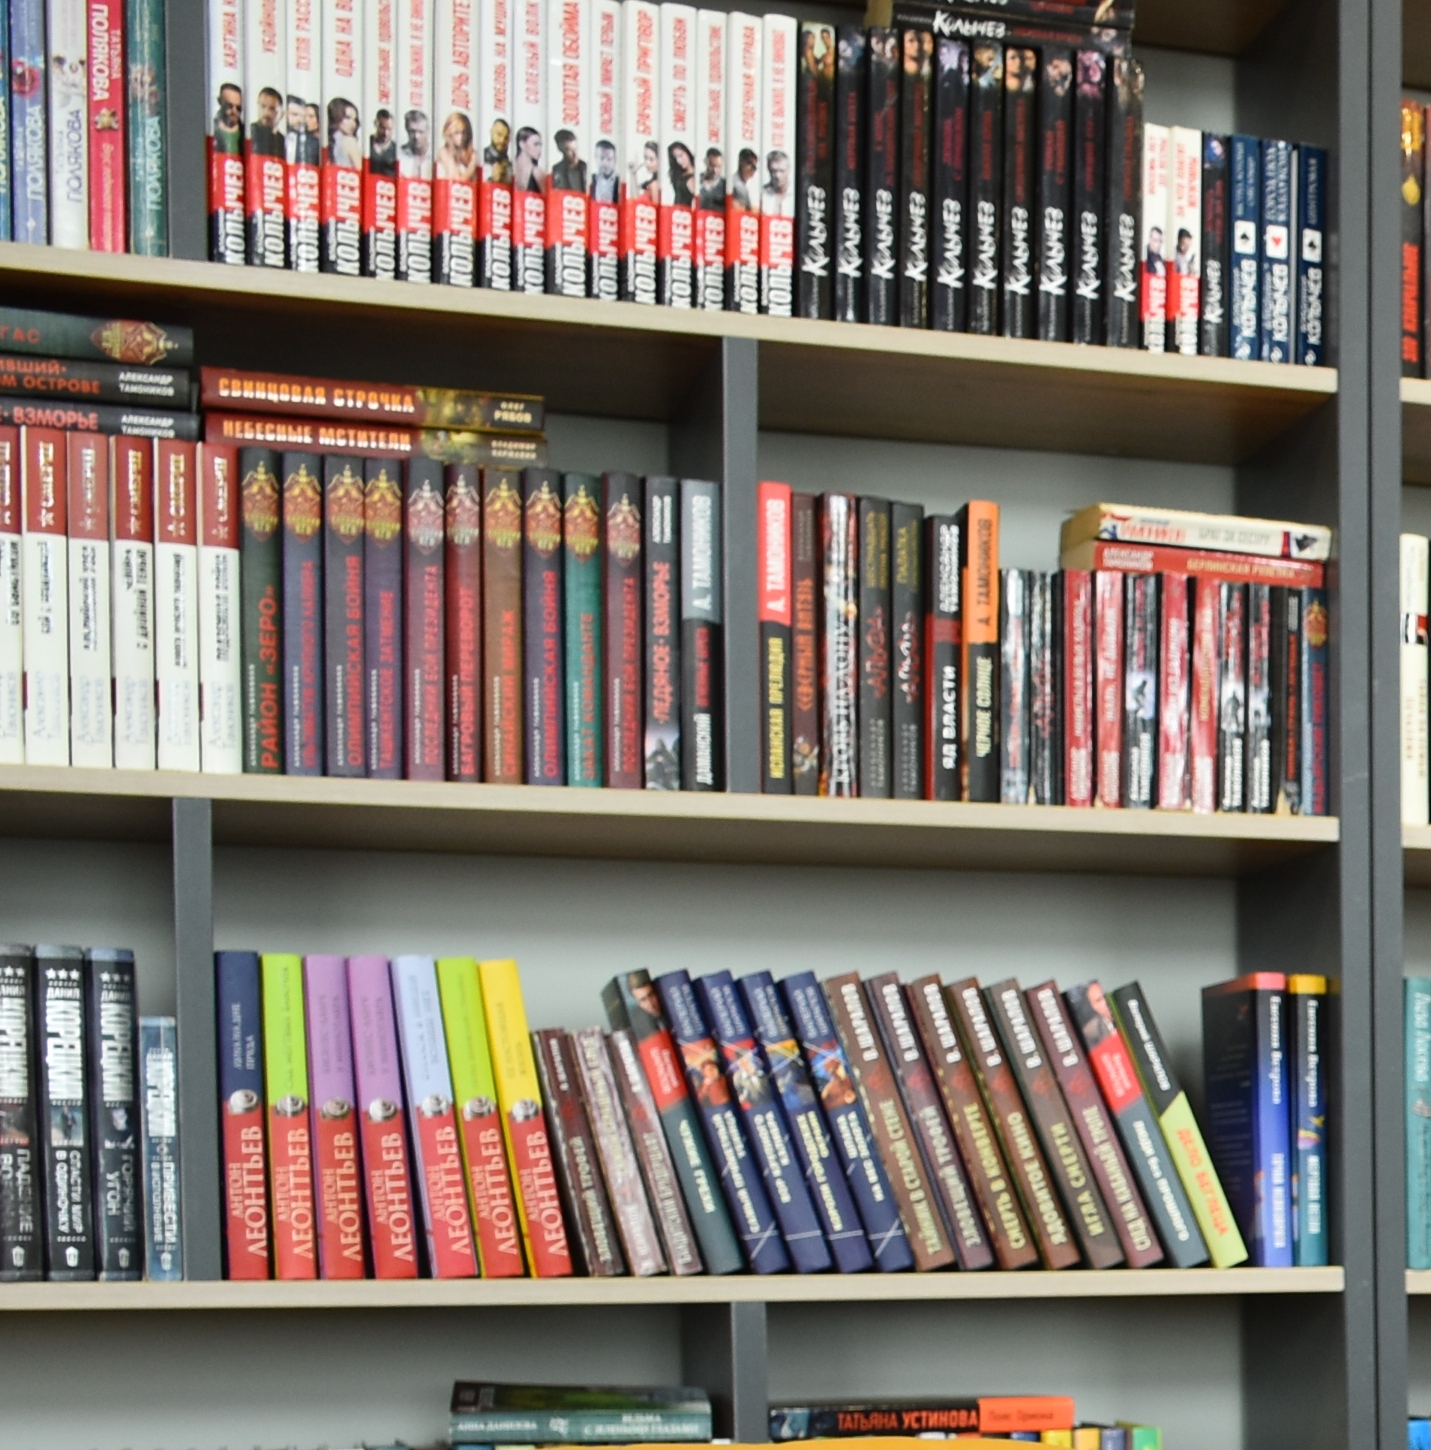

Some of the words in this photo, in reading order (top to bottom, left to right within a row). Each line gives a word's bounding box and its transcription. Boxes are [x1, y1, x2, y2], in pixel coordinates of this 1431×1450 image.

[92, 3, 109, 101] ПОЛЯКОВА
[222, 12, 239, 69] КАРТИНА
[560, 2, 579, 60] ОБОЙМА
[637, 10, 654, 73] ПРИГОВОР
[673, 17, 686, 61] ЛЮБВИ
[452, 70, 470, 111] ДОЧЬ
[562, 63, 579, 126] ЗОЛОТАЯ
[635, 77, 652, 135] БРАЧНЫЙ
[673, 85, 686, 131] СМЕРТЬ
[67, 109, 82, 203] ПОЛЯКОВА
[225, 159, 243, 265] КОЛЫЧЕВ
[264, 161, 284, 268] КОЛЫЧЕВ
[297, 169, 319, 271] КОЛЫЧЕВ
[337, 171, 359, 275] КОЛЫЧЕВ
[376, 180, 395, 280] КОЛЫЧЕВ
[408, 182, 431, 283] КОЛЫЧЕВ
[23, 376, 100, 394] ОСТРОВЕ
[119, 372, 173, 385] АЛЕКСАНДР
[119, 383, 174, 397] ТАМОНИКОВ
[219, 376, 326, 405] СВИНЦОВАЯ
[333, 389, 415, 413] СТРОЧКА
[13, 406, 98, 430] ВЗМОРЬЕ
[122, 415, 174, 428] АЛЕКСАНДР
[223, 420, 313, 444] НЕБЕСНЫЕ
[319, 426, 411, 451] МСТИТЕЛИ
[692, 495, 712, 588] ТАМОНИКОВ
[767, 499, 785, 592] ТАМОНИКОВ
[345, 556, 362, 619] БОЙНЯ
[542, 570, 557, 633] БОЙНЯ
[653, 561, 671, 636] ВЗМОРЬЕ
[259, 585, 279, 675] «ЗЕРО»
[459, 588, 475, 681] ПЕРЕВОРОТ
[503, 610, 515, 670] МИРАЖ
[346, 624, 363, 766] ОЛИМПИЙСКАЯ
[769, 638, 785, 704] ПРЕЛЮДИЯ
[943, 666, 956, 739] ВЛАСТИ
[977, 656, 993, 707] СОЛНЦЕ
[257, 682, 279, 768] РАЙОН
[459, 686, 475, 775] БАГРОВЫЙ
[502, 675, 516, 777] СИНАЙСКИЙ
[543, 638, 559, 777] ОЛИМПИЙСКАЯ
[976, 709, 992, 757] ЧЕРНОЕ
[769, 708, 784, 778] ИСПАНСКАЯ
[943, 743, 956, 769] ЯД
[964, 1104, 1000, 1177] КОНВЕРТЕ
[1007, 1112, 1035, 1158] КИНО
[1051, 1123, 1086, 1188] СМЕРТИ
[107, 1171, 120, 1216] УГОН
[229, 1162, 244, 1217] АНТОН
[241, 1126, 268, 1258] ЛЕОНТЬЕВ
[275, 1166, 290, 1222] АНТОН
[288, 1127, 314, 1259] ЛЕОНТЬЕВ
[323, 1168, 338, 1223] АНТОН
[334, 1131, 362, 1261] ЛЕОНТЬЕВ
[380, 1132, 414, 1262] ЛЕОНТЬЕВ
[436, 1126, 472, 1255] ЛЕОНТЬЕВ
[480, 1130, 517, 1255] ЛЕОНТЬЕВ
[527, 1131, 568, 1256] ЛЕОНТЬЕВ
[1024, 1158, 1068, 1245] ЯДОВИТОЕ
[1133, 1120, 1153, 1157] ЛЮДИ
[1157, 1180, 1188, 1240] ПРОШЛОГО
[1175, 1127, 1198, 1165] ДЕЛО
[1195, 1168, 1229, 1237] БЕГЛЕЦА
[71, 1205, 84, 1234] МИР
[997, 1197, 1027, 1249] СМЕРТЬ
[1076, 1190, 1104, 1237] ИГЛА
[837, 1411, 898, 1431] ТАТЬЯНА
[902, 1409, 979, 1430] УСТИНОВА
